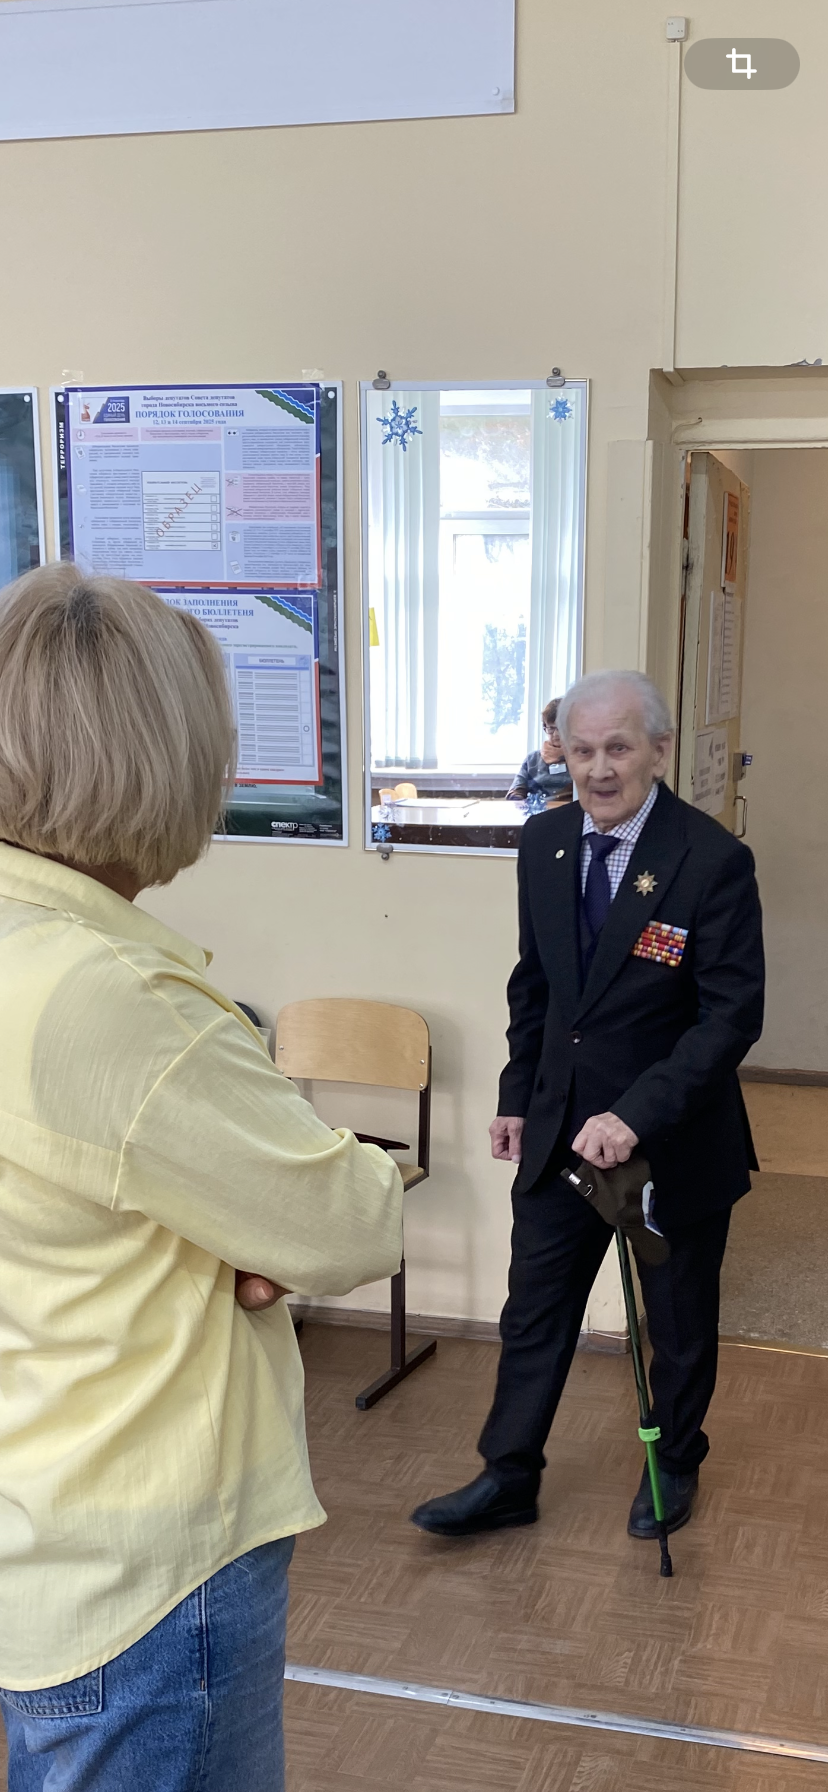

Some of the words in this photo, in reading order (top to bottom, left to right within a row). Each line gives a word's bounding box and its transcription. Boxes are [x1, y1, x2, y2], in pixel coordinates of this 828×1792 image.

[210, 394, 235, 402] депутатов
[107, 402, 126, 413] 2025
[158, 401, 195, 409] Новосибирска
[135, 410, 177, 419] ПОРЯДОК
[177, 409, 245, 418] ГОЛОСОВАНИЯ
[178, 418, 202, 426] сентября
[58, 421, 66, 470] ТЕРРОРИЗМ
[156, 483, 203, 538] ОБРАЗЕЦ
[183, 598, 239, 607] ЗАПОЛНЕНИЯ
[202, 607, 254, 617] БЮЛЛЕТЕНЯ
